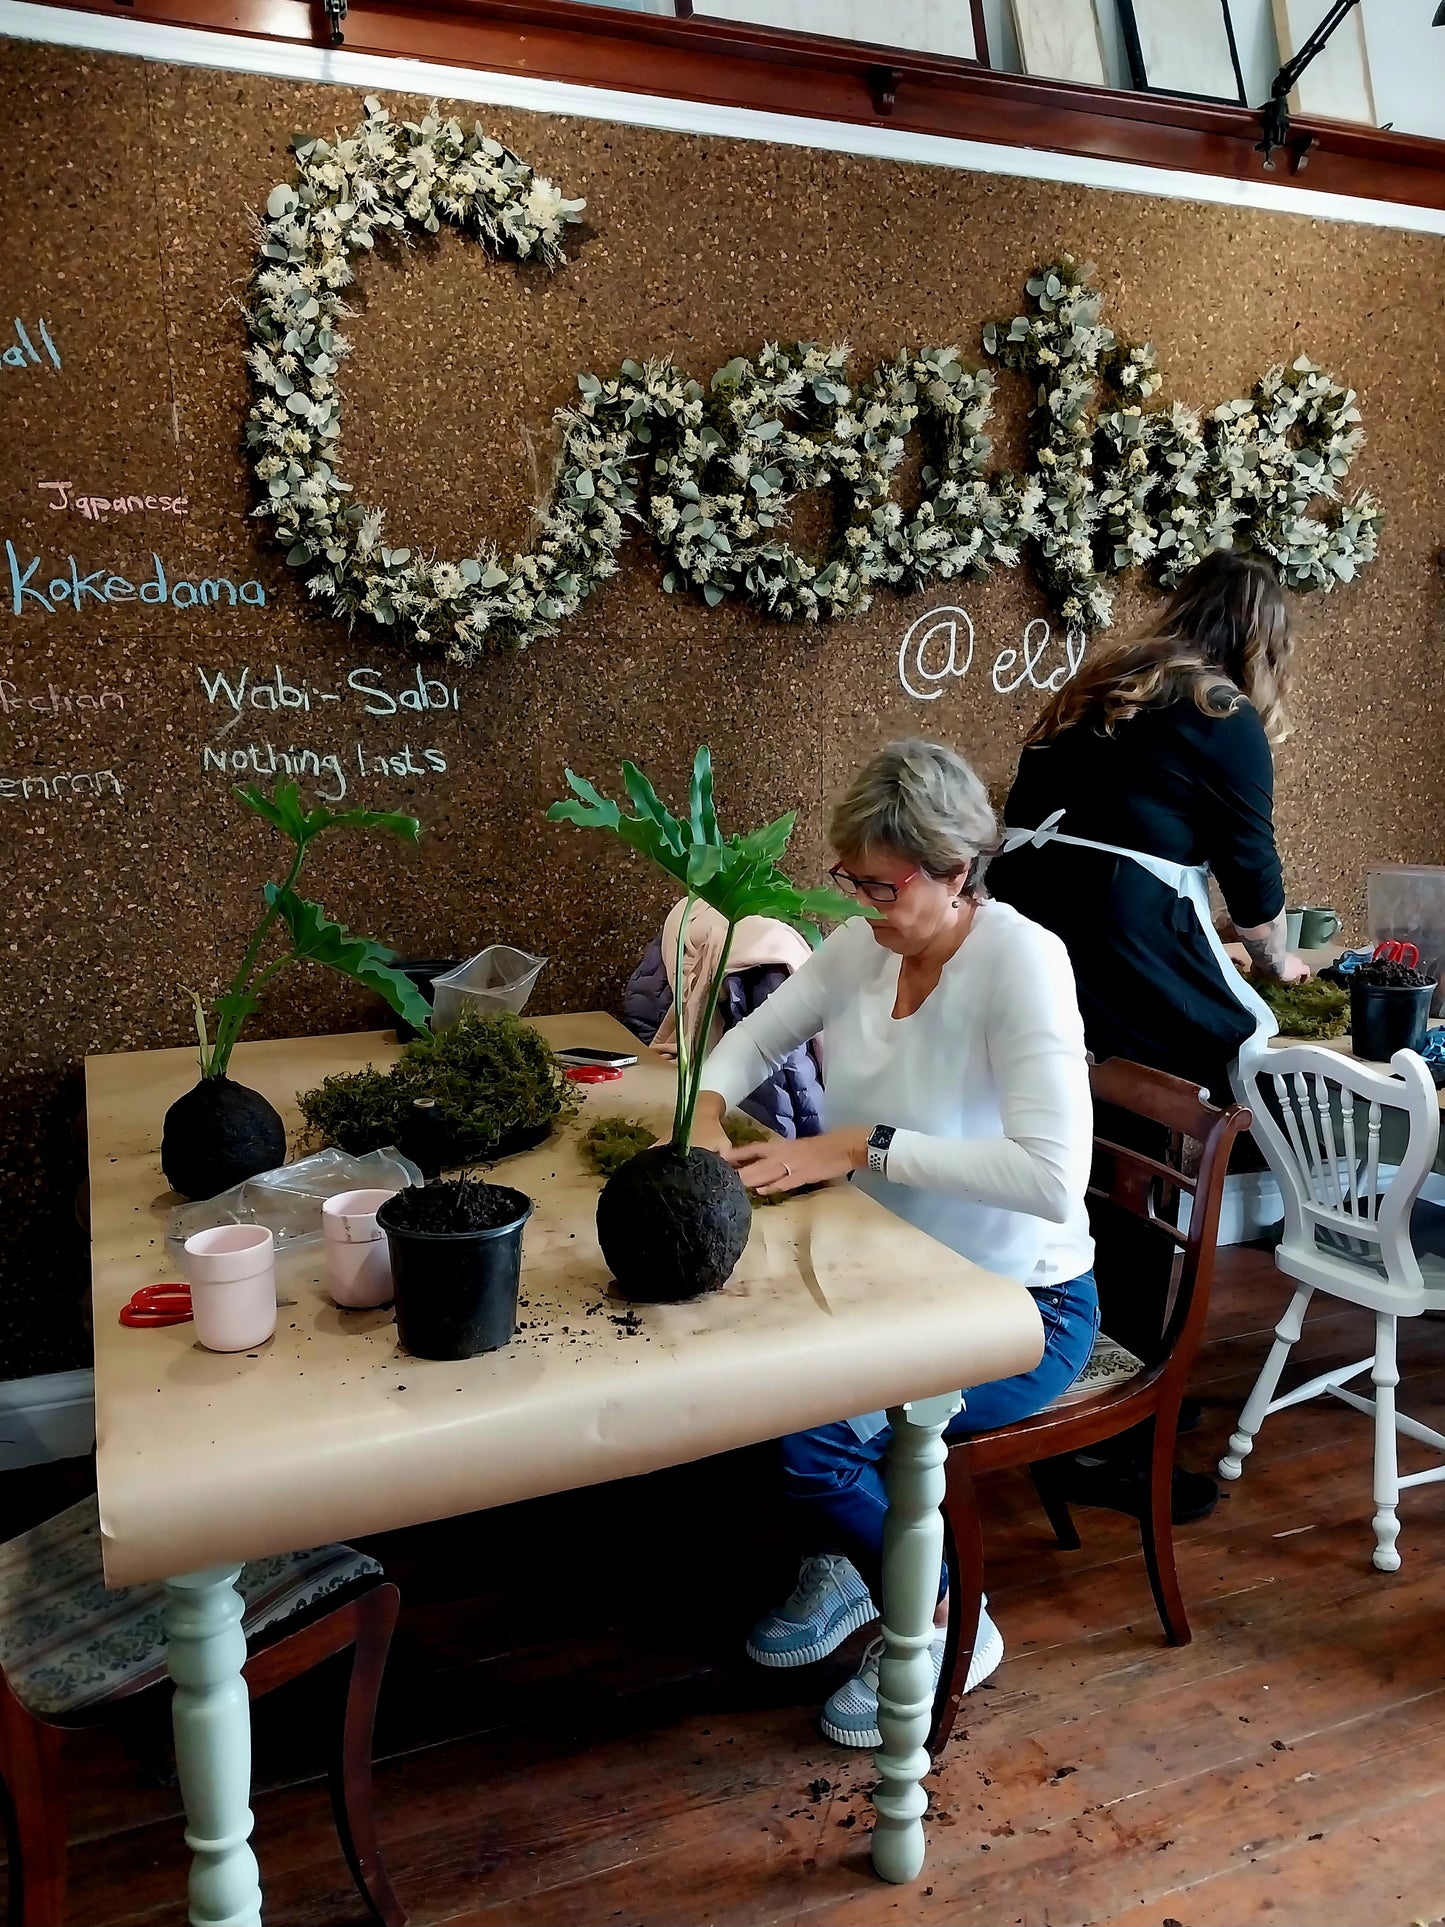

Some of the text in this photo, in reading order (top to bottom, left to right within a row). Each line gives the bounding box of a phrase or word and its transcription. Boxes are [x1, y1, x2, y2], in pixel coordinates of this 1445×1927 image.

[0, 316, 62, 370] all
[38, 480, 189, 520] Japanese
[6, 539, 267, 616] Kokedama
[197, 661, 460, 715] Wabi-Sabi
[203, 743, 347, 801] Nothing
